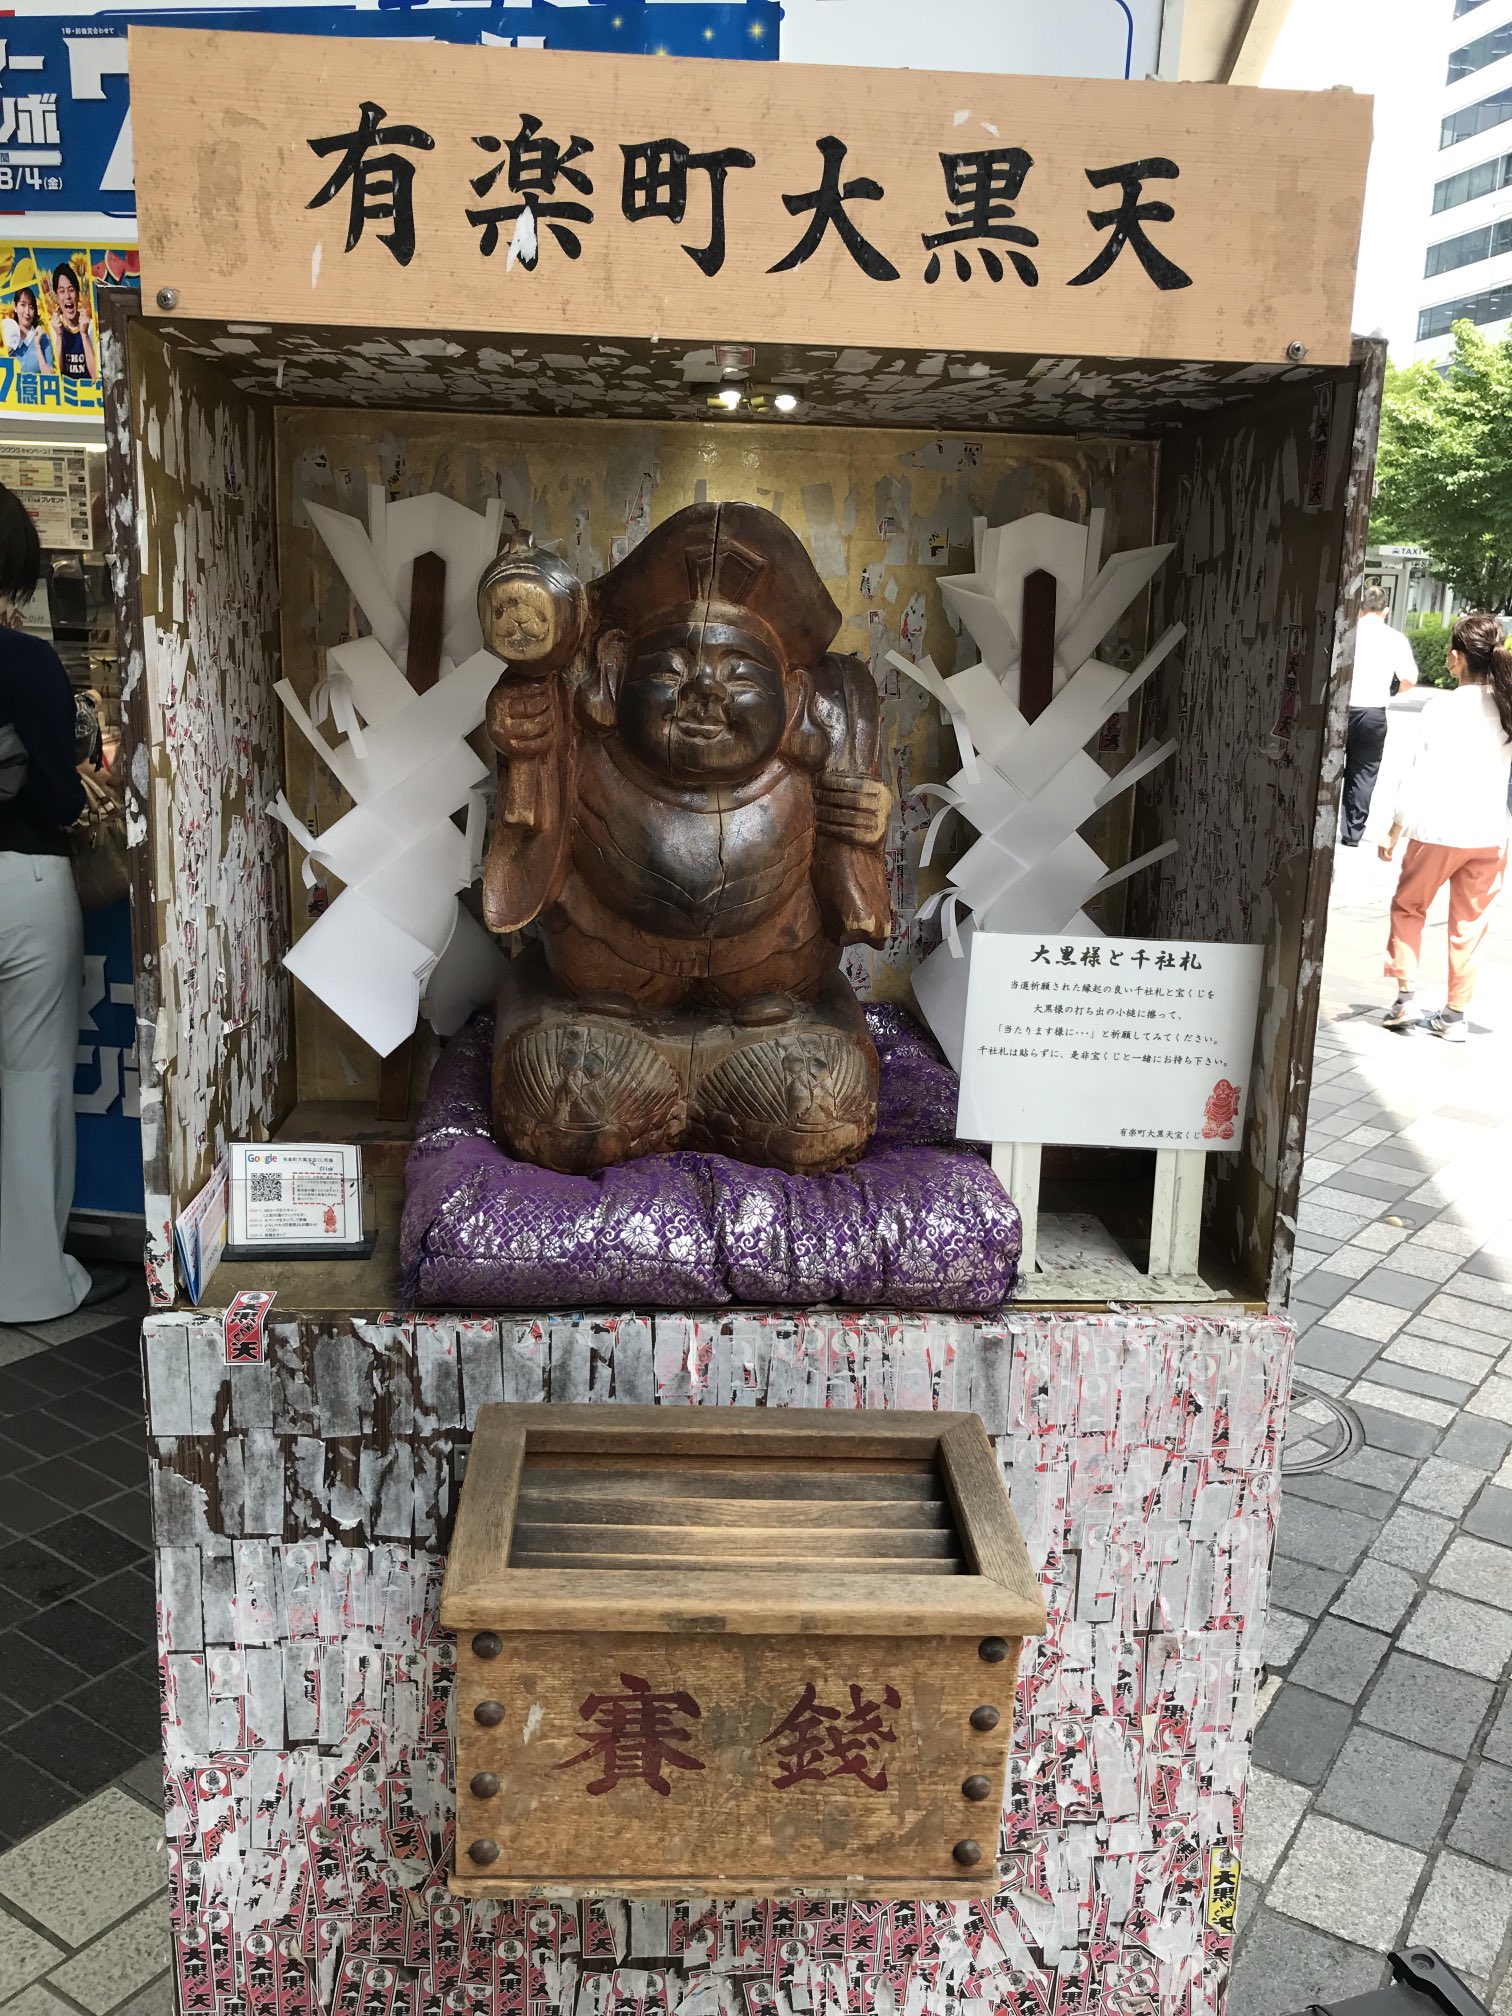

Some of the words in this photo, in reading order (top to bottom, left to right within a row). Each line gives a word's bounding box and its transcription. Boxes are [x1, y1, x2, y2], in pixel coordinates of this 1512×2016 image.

[304, 101, 1194, 291] 有楽町大黒天
[1030, 944, 1202, 971] 大黒様と千社札
[1010, 980, 1215, 999] 当選祈願された縁起の良い千社札と宝くじを
[1119, 1128, 1201, 1140] 有楽町大黒天宝くじ
[247, 1153, 278, 1164] Google
